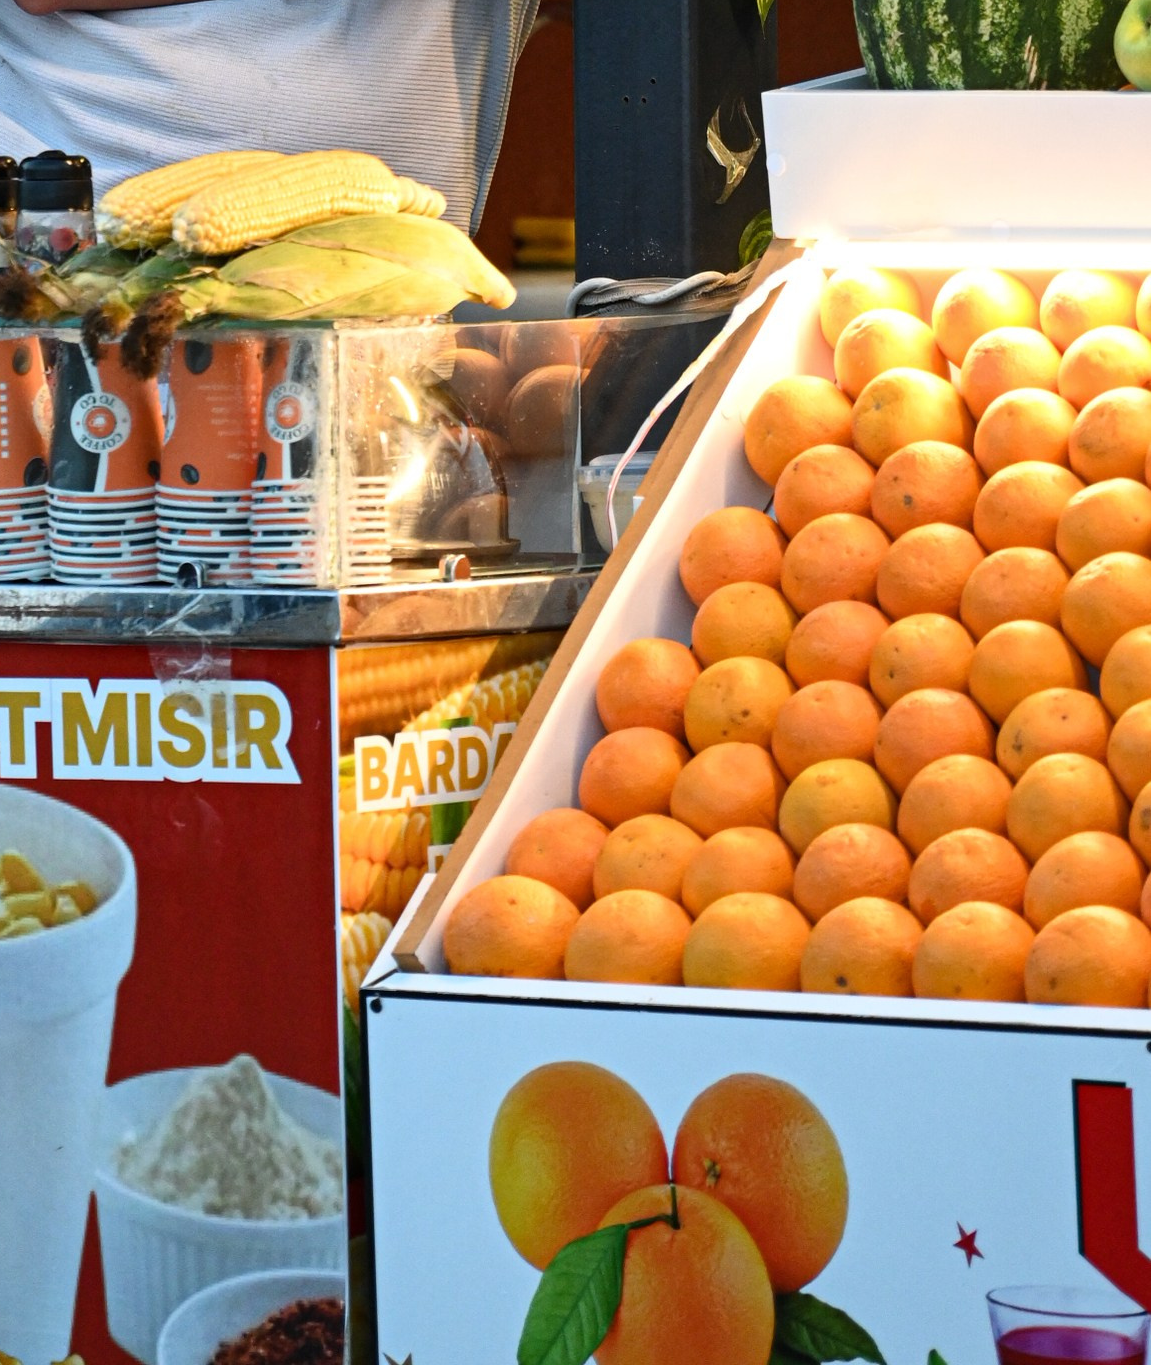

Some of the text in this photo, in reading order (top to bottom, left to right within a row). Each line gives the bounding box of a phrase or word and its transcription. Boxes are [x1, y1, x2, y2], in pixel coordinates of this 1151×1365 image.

[80, 395, 96, 409] GO
[80, 432, 123, 450] COFFEE
[61, 691, 285, 771] MISIR
